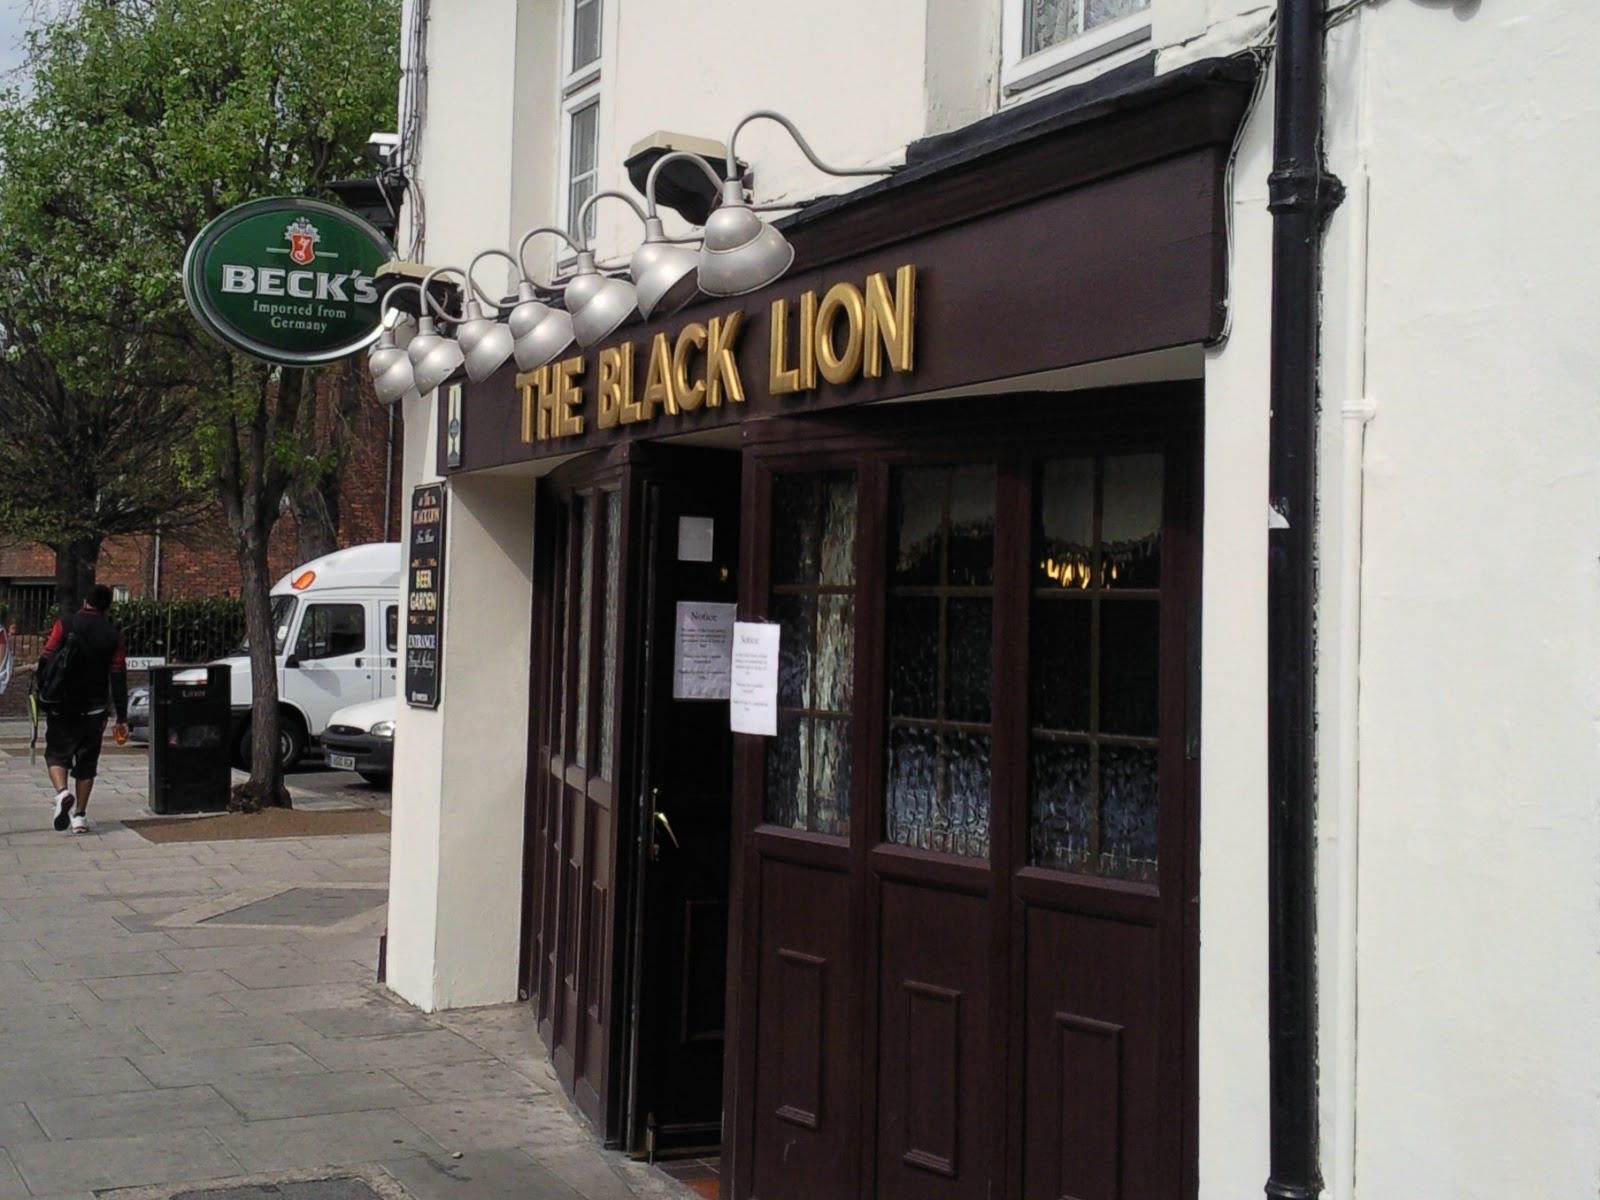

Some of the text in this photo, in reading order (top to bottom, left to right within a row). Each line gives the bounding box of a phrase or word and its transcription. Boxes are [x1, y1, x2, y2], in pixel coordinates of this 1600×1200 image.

[221, 264, 379, 304] BECK'S
[253, 300, 346, 319] Imported from
[270, 316, 328, 333] Germany
[516, 264, 916, 443] THE BLACK LION
[415, 569, 432, 588] BEER
[410, 591, 437, 610] GARDEN
[690, 611, 718, 622] Notice
